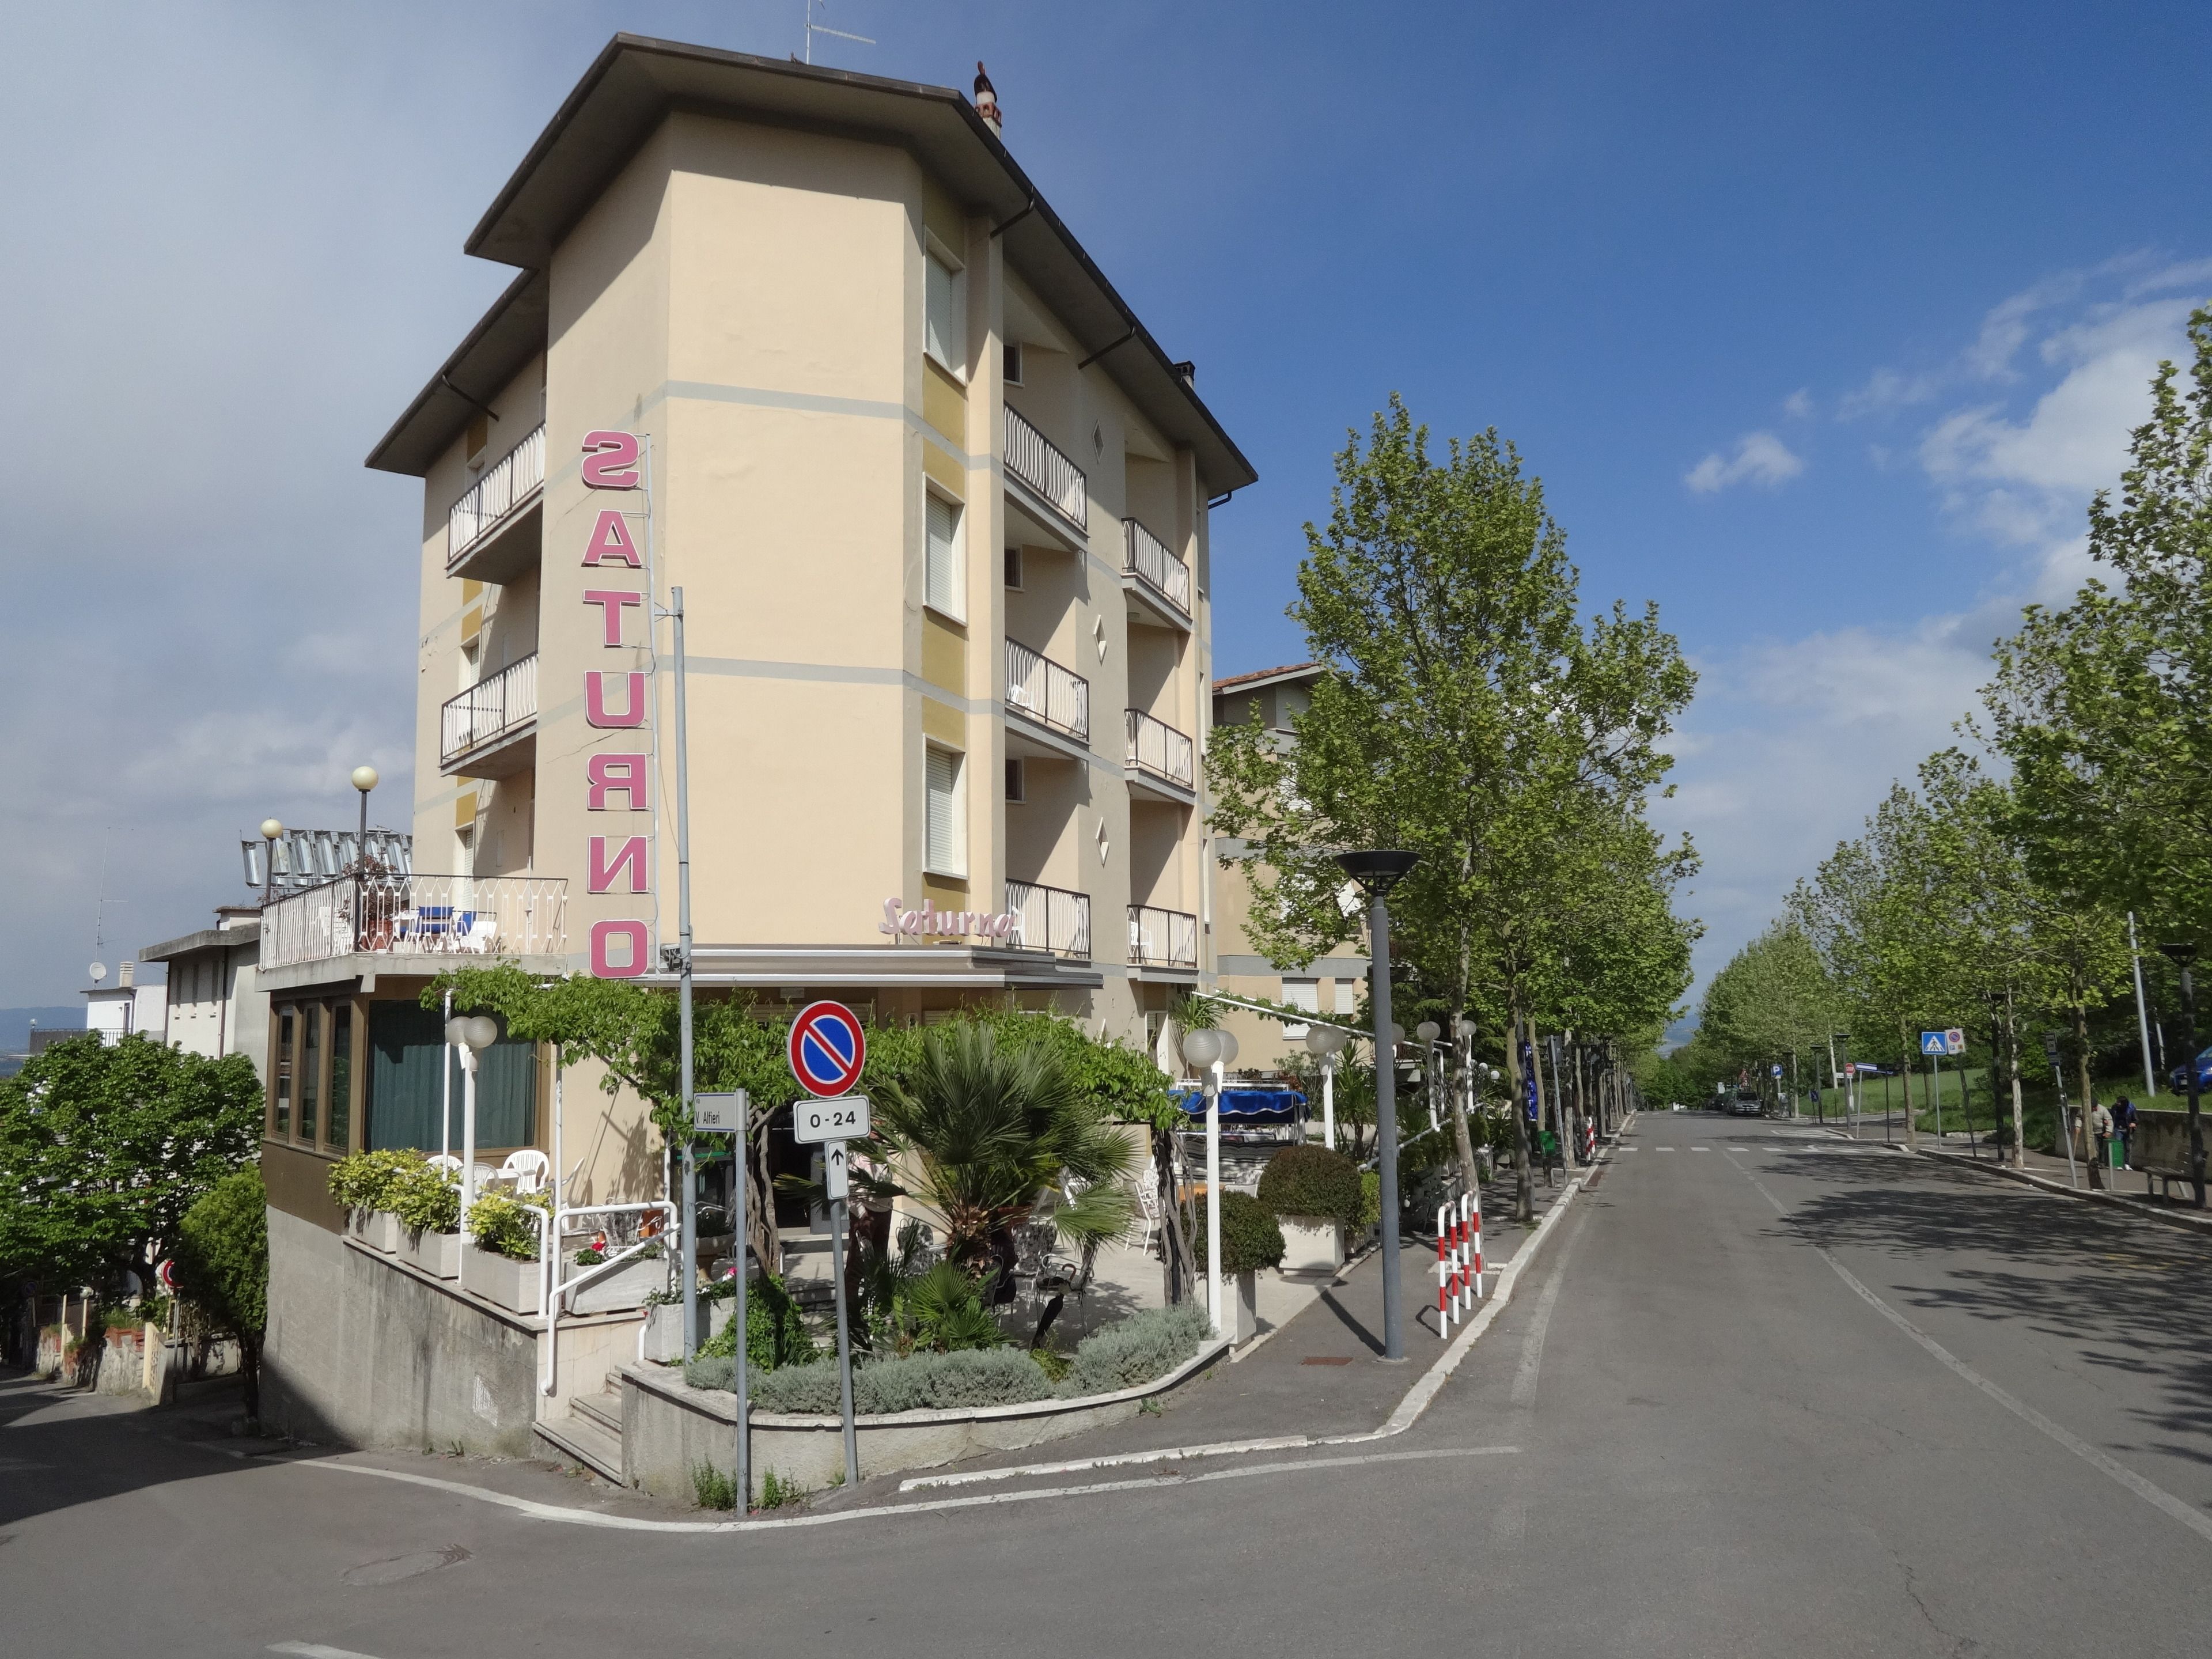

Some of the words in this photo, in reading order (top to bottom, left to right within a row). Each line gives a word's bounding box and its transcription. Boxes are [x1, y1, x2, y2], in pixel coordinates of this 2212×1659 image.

[878, 897, 1016, 938] Saturno
[1773, 1066, 1780, 1074] P
[695, 1111, 700, 1124] V.
[703, 1111, 720, 1124] Alfieri
